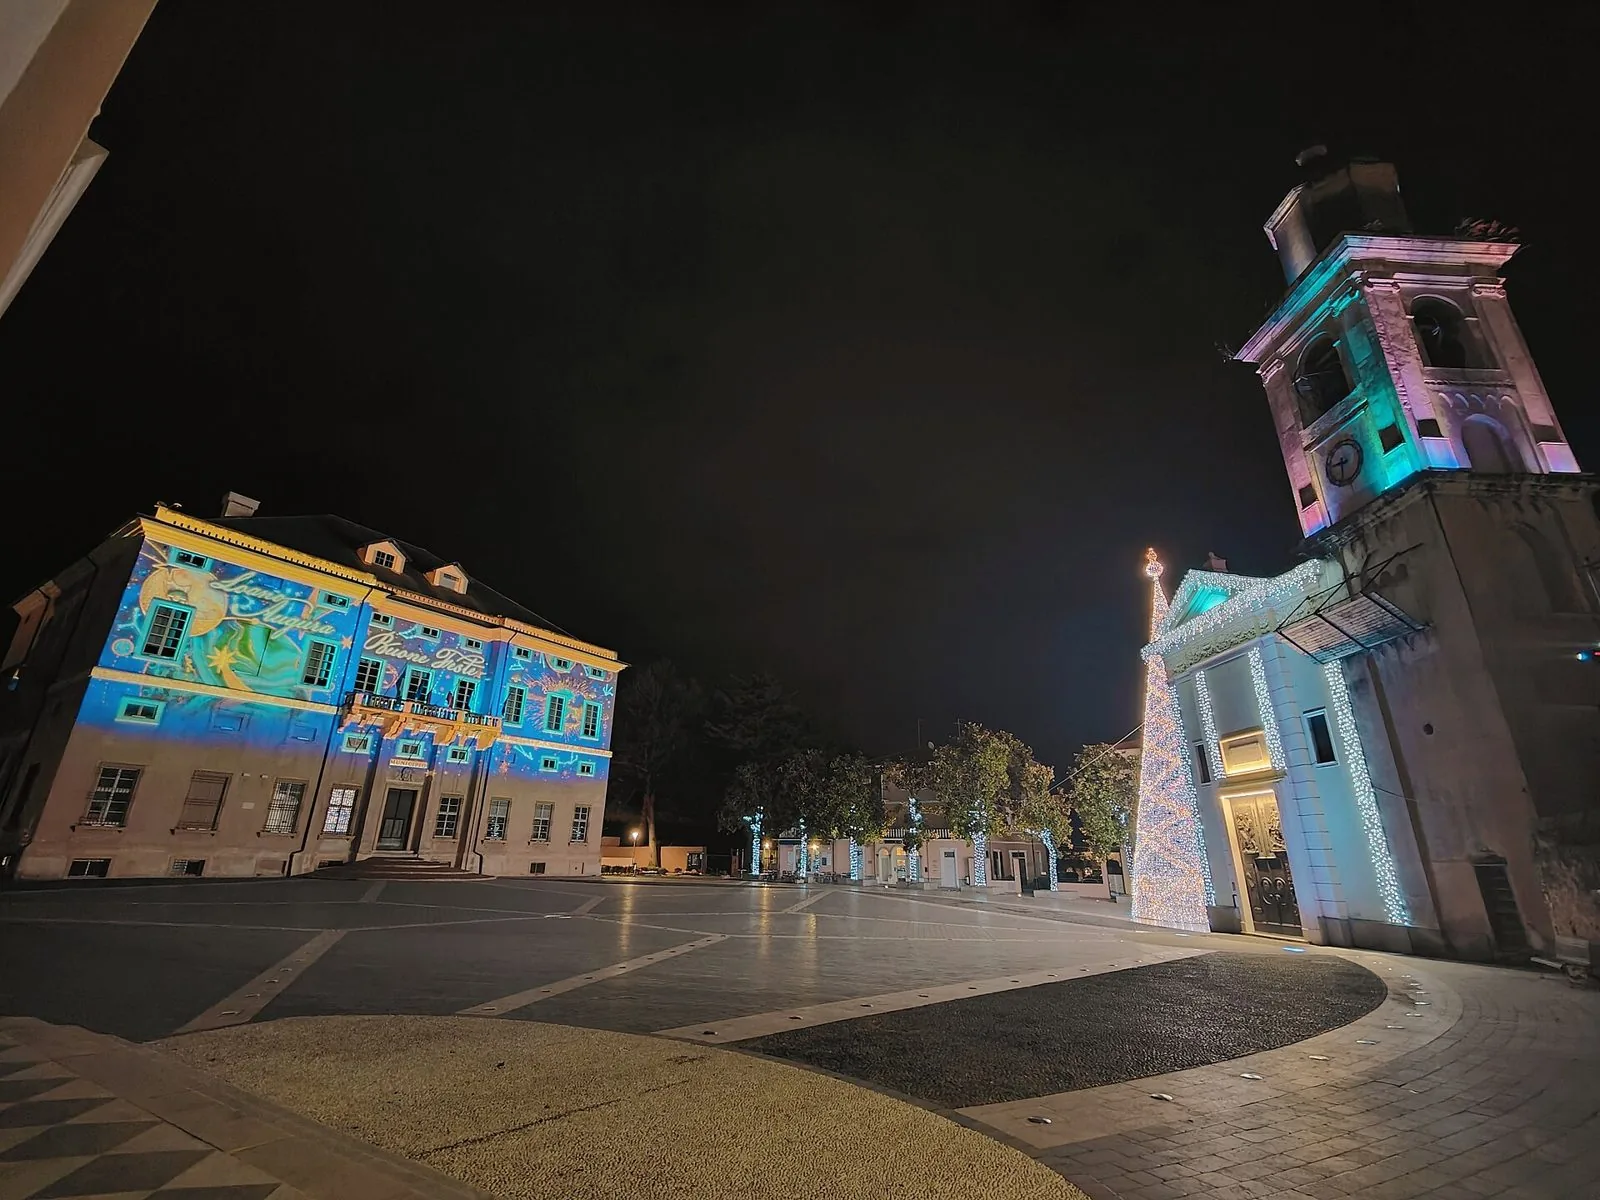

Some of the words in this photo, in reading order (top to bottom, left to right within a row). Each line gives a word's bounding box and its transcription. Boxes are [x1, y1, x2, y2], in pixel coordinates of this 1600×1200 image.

[210, 571, 285, 603] Loano
[232, 597, 336, 639] Augura
[363, 631, 430, 664] Buone
[431, 648, 487, 678] Feste
